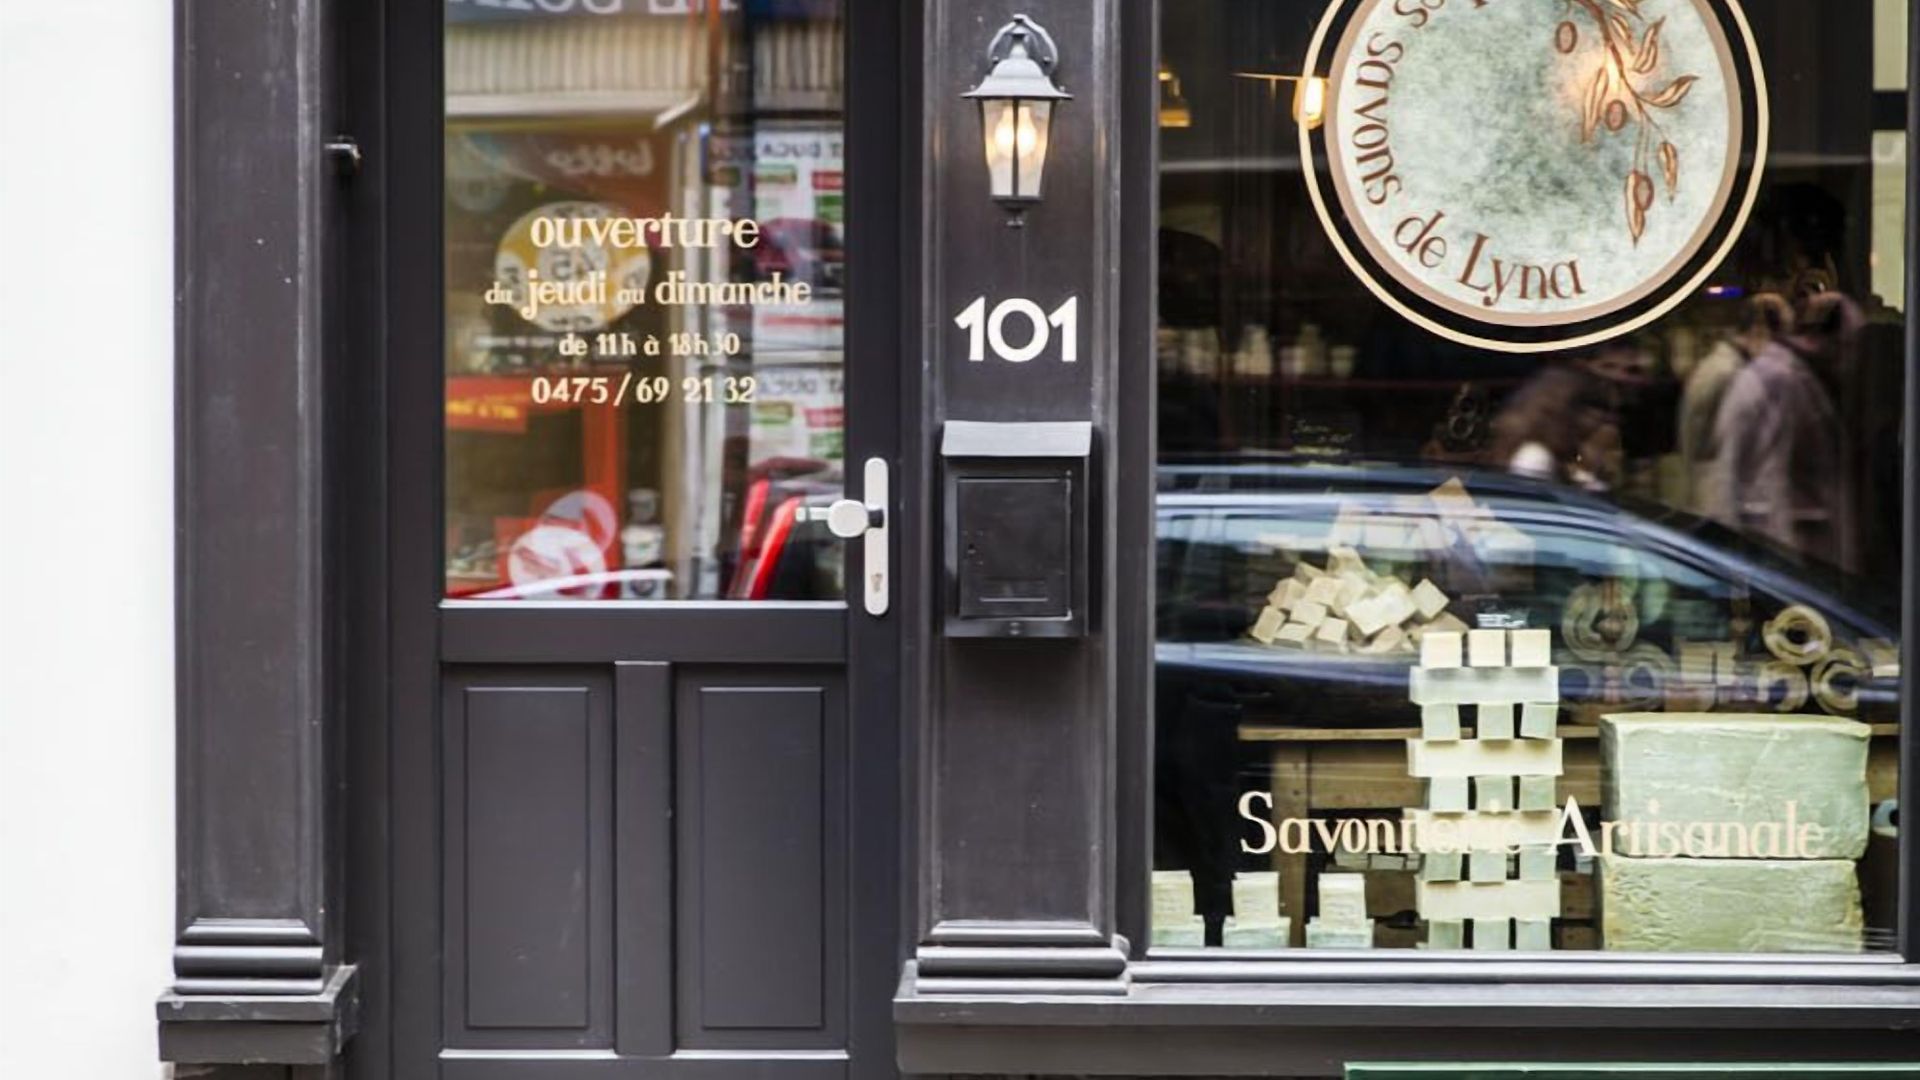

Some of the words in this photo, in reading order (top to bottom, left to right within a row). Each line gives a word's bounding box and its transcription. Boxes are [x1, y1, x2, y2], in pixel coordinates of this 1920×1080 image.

[1352, 32, 1403, 207] savons
[1393, 210, 1448, 269] de
[1457, 232, 1586, 307] Lyna
[530, 211, 760, 249] ouverture
[484, 286, 513, 305] du
[520, 269, 607, 321] jeudi
[616, 287, 645, 305] au
[655, 271, 812, 305] dimanche
[559, 333, 588, 356] de
[643, 334, 660, 356] à
[954, 295, 1078, 363] 101
[682, 377, 714, 403] 21
[727, 376, 757, 403] 32
[1238, 790, 1524, 855] Savonnerie
[1550, 794, 1826, 858] Artisanale
